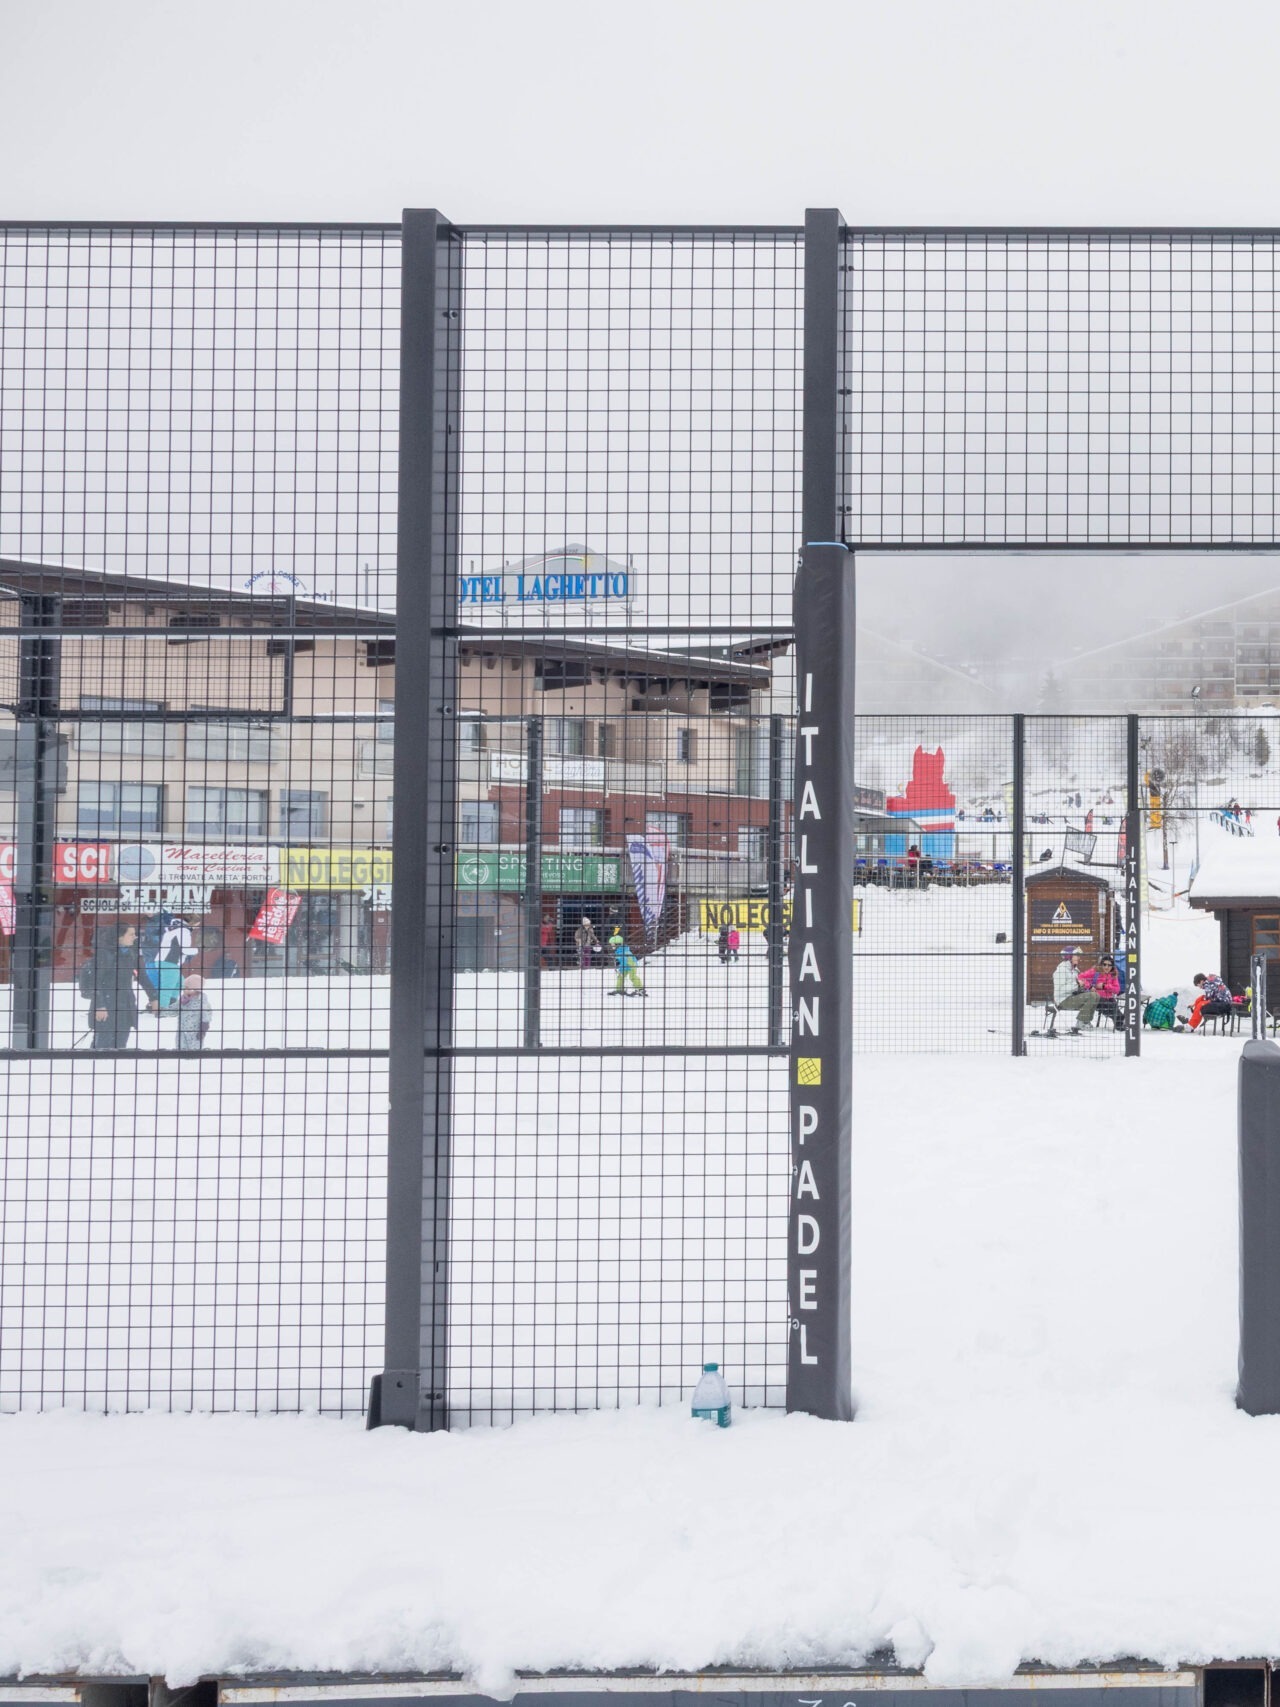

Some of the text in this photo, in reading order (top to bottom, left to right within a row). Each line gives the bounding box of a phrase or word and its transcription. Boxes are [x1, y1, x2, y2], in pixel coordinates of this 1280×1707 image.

[458, 572, 628, 603] OTEL LAGHETTO
[62, 846, 107, 879] SCI
[288, 855, 392, 884] NOLEGGI
[499, 856, 584, 872] SPOTING
[705, 903, 792, 929] NOLEGG
[1128, 846, 1137, 1040] ITALIAN PADEL
[797, 672, 822, 1365] ITALIAN PADEL
